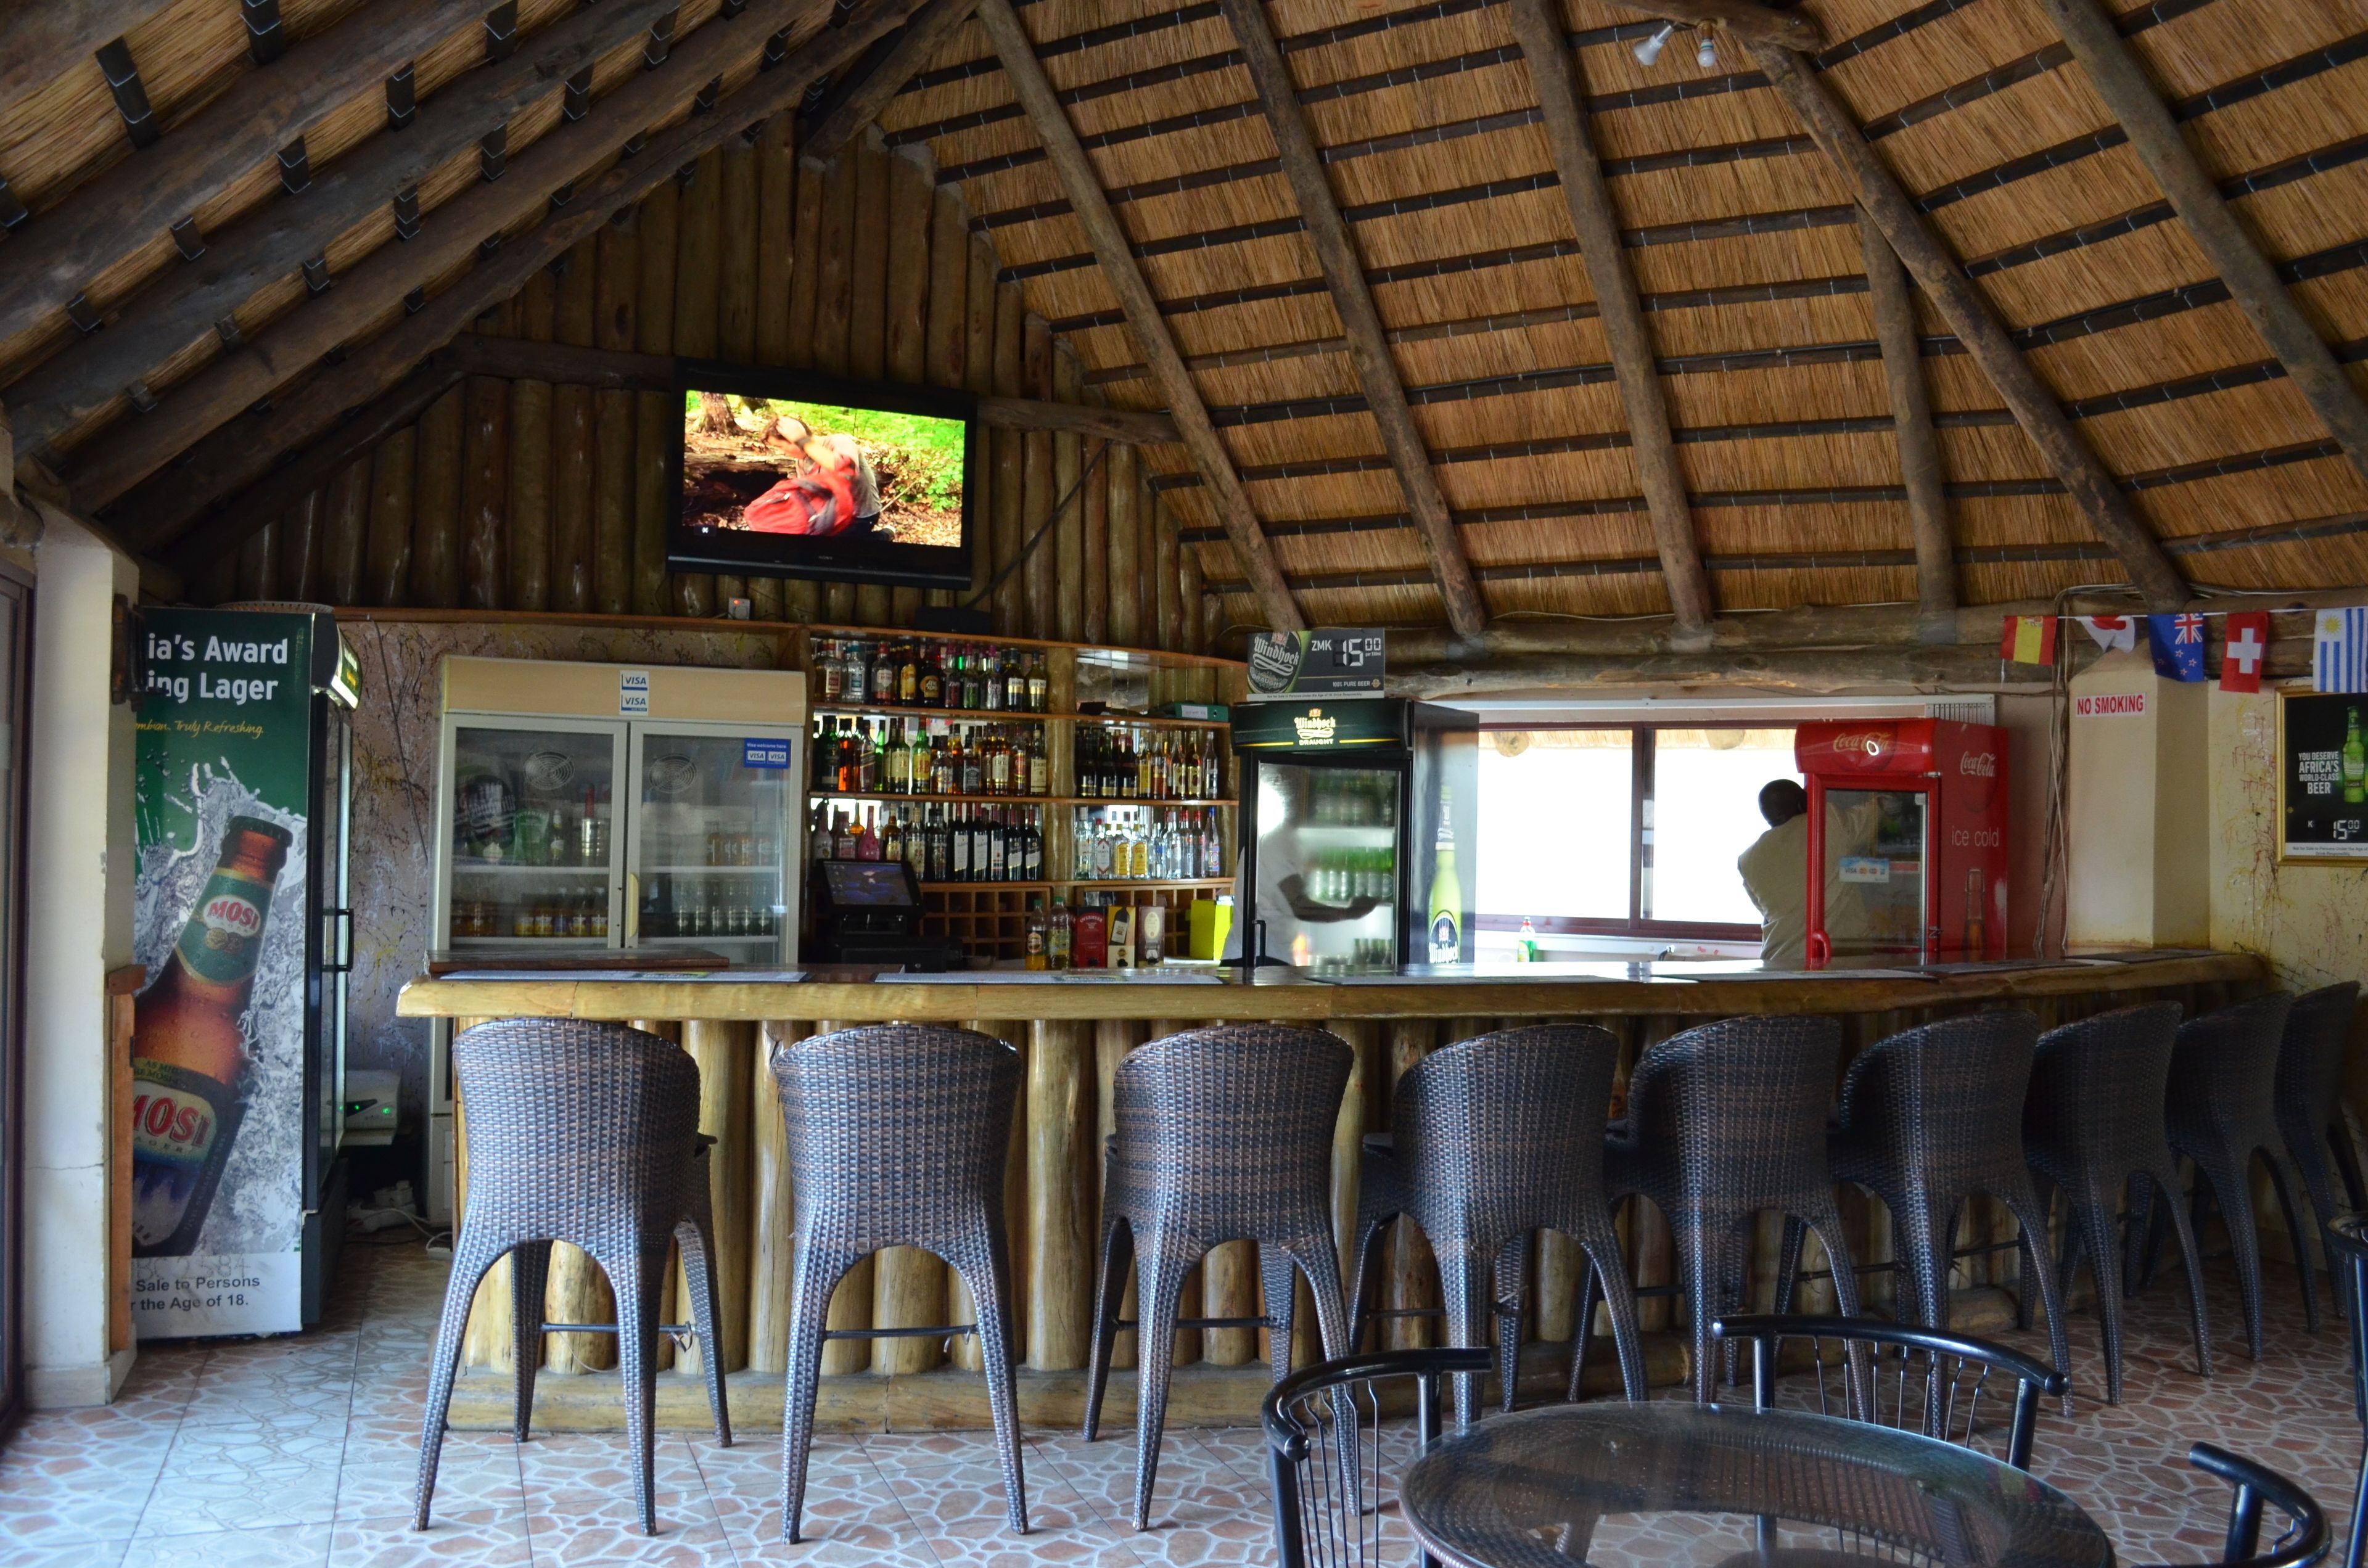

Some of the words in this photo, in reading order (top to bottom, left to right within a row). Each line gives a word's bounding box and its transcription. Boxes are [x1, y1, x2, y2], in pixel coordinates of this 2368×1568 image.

[204, 635, 288, 664] Award
[1254, 636, 1299, 665] Windhoek
[1311, 639, 1332, 651] ZMK
[1342, 638, 1363, 667] 15
[1365, 638, 1381, 651] 00
[200, 672, 279, 705] Lager
[625, 676, 646, 685] VISA
[625, 697, 646, 705] VISA
[2077, 697, 2091, 715] NO
[2095, 694, 2144, 714] SMOKING
[175, 720, 201, 737] Truly
[204, 720, 264, 739] Refreshing.
[1294, 716, 1336, 729] Windhoek
[2298, 752, 2311, 761] YOU
[2311, 751, 2339, 760] DESERVE
[2298, 760, 2339, 773] AFRICA'S
[2298, 773, 2339, 782] WORLD-CLASS
[2307, 782, 2331, 794] BEER
[1951, 825, 1969, 846] ice
[1974, 827, 1999, 847] cold
[2333, 819, 2348, 840] 15
[207, 900, 259, 931] MOSI
[136, 1278, 170, 1292] Sale
[175, 1279, 191, 1291] to
[196, 1276, 260, 1289] Persons
[140, 1297, 165, 1311] the
[170, 1297, 201, 1311] Age
[207, 1294, 222, 1307] of
[227, 1294, 249, 1307] 18.
